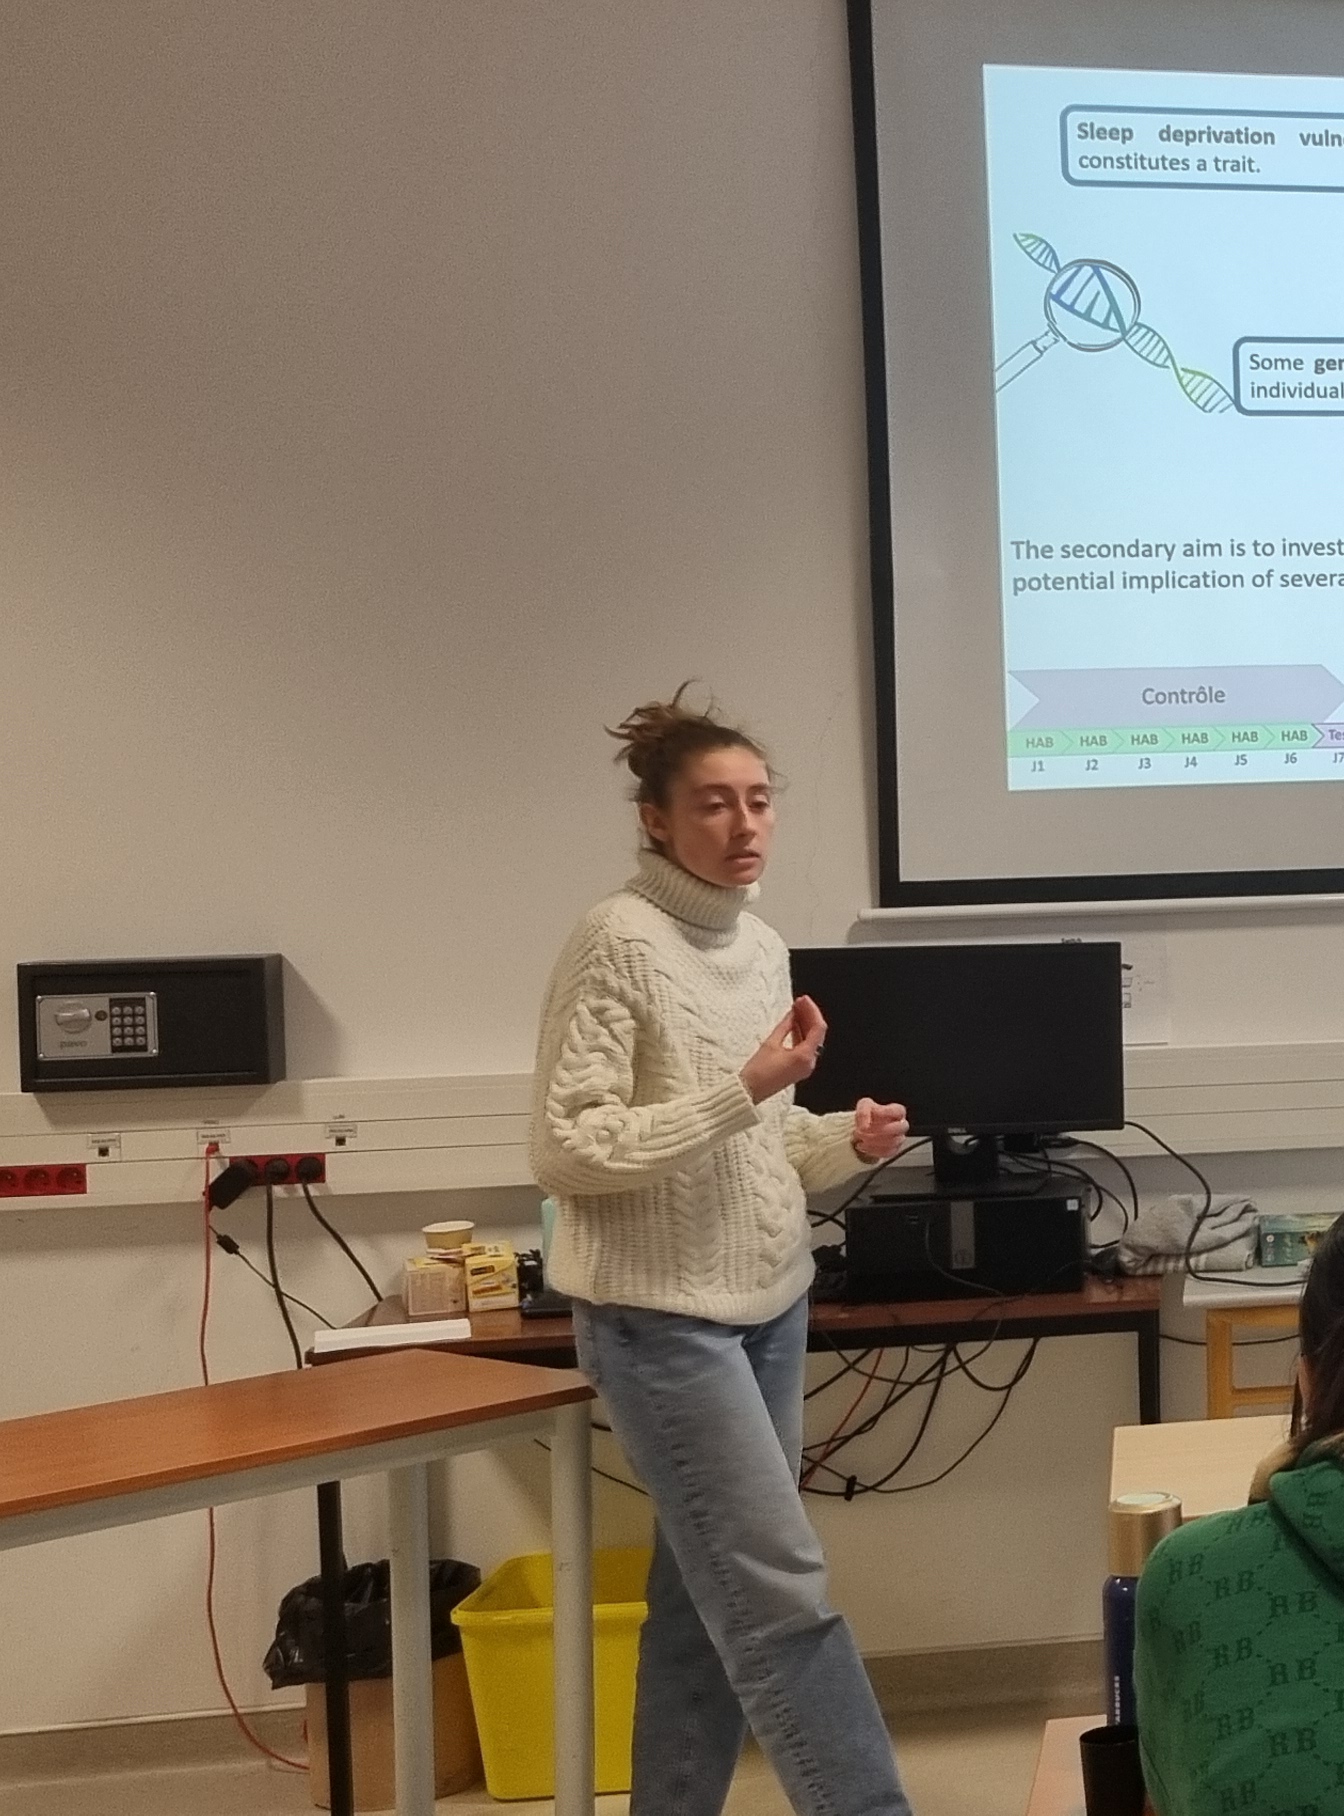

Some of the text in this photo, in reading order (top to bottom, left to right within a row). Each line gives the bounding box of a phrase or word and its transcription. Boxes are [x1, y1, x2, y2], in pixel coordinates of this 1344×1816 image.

[1076, 121, 1134, 146] Sleep
[1157, 123, 1276, 148] deprivation
[1078, 151, 1261, 174] constitutes a trait.
[1248, 353, 1305, 371] Some
[1009, 538, 1055, 561] The
[1060, 537, 1177, 563] secondary
[1182, 537, 1223, 558] aim
[1229, 537, 1247, 558] is
[1251, 539, 1276, 558] to
[1012, 569, 1115, 597] potential
[1121, 569, 1245, 595] implication
[1251, 568, 1276, 589] of
[1141, 684, 1226, 706] Contrôle
[1025, 736, 1055, 749] HAB
[1079, 734, 1108, 747] HAB
[1130, 733, 1159, 746] HAB
[1181, 732, 1210, 745] HAB
[1231, 730, 1259, 744] HAB
[1280, 729, 1309, 742] HAB
[1030, 759, 1045, 773] J1
[1084, 758, 1099, 772] J2
[1137, 756, 1152, 770] J3
[1183, 755, 1199, 769] J4
[1233, 753, 1249, 767] J5
[1283, 751, 1298, 765] J6
